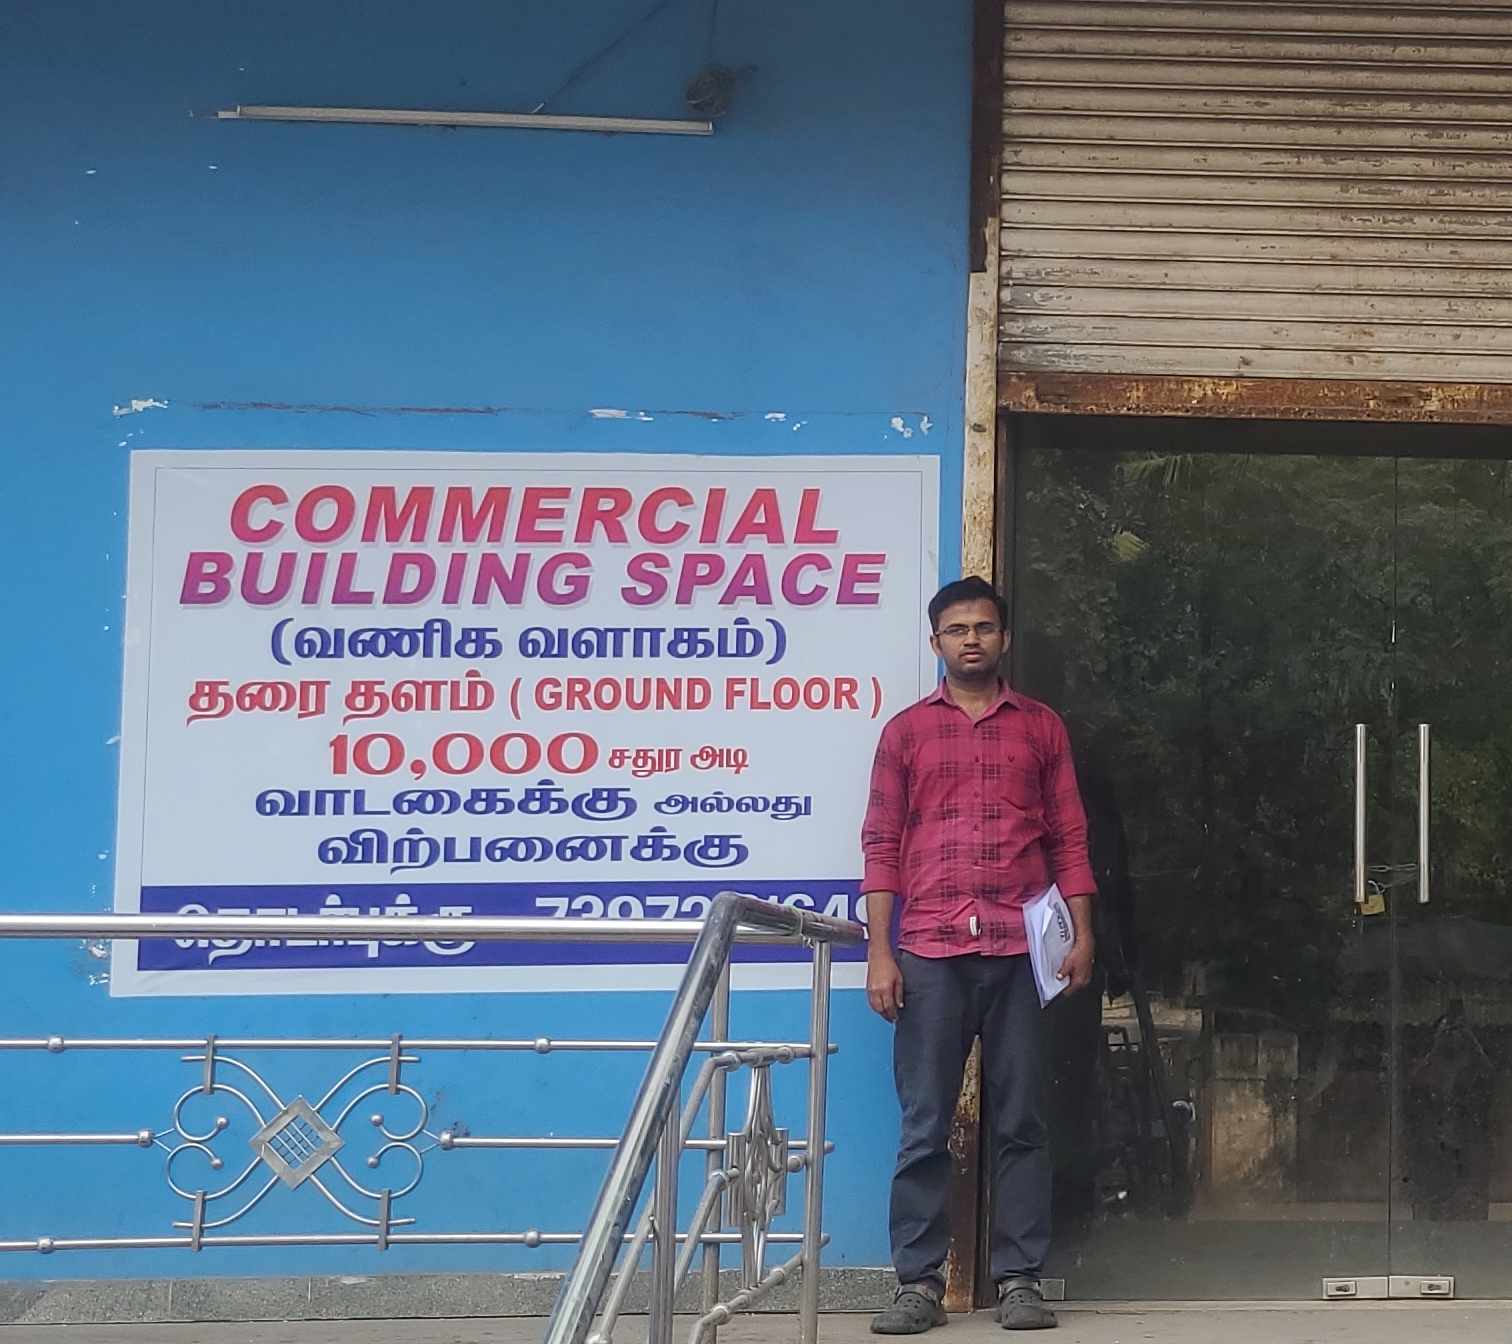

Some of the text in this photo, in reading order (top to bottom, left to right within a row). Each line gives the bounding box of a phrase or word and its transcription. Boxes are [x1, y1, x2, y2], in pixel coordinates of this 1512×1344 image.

[231, 484, 841, 546] COMMERCIAL
[180, 552, 887, 607] BUILDING SPACE
[270, 616, 787, 666] (வணிக வளாகம்)
[187, 676, 331, 725] தரை
[343, 669, 495, 725] தளம்
[535, 678, 712, 711] GROUND
[725, 678, 860, 710] FLOOR
[329, 732, 750, 780] 10,000 சதுர அடி
[255, 779, 813, 822] வாடகைக்கு அல்லது
[317, 825, 750, 875] விற்பனைக்கு
